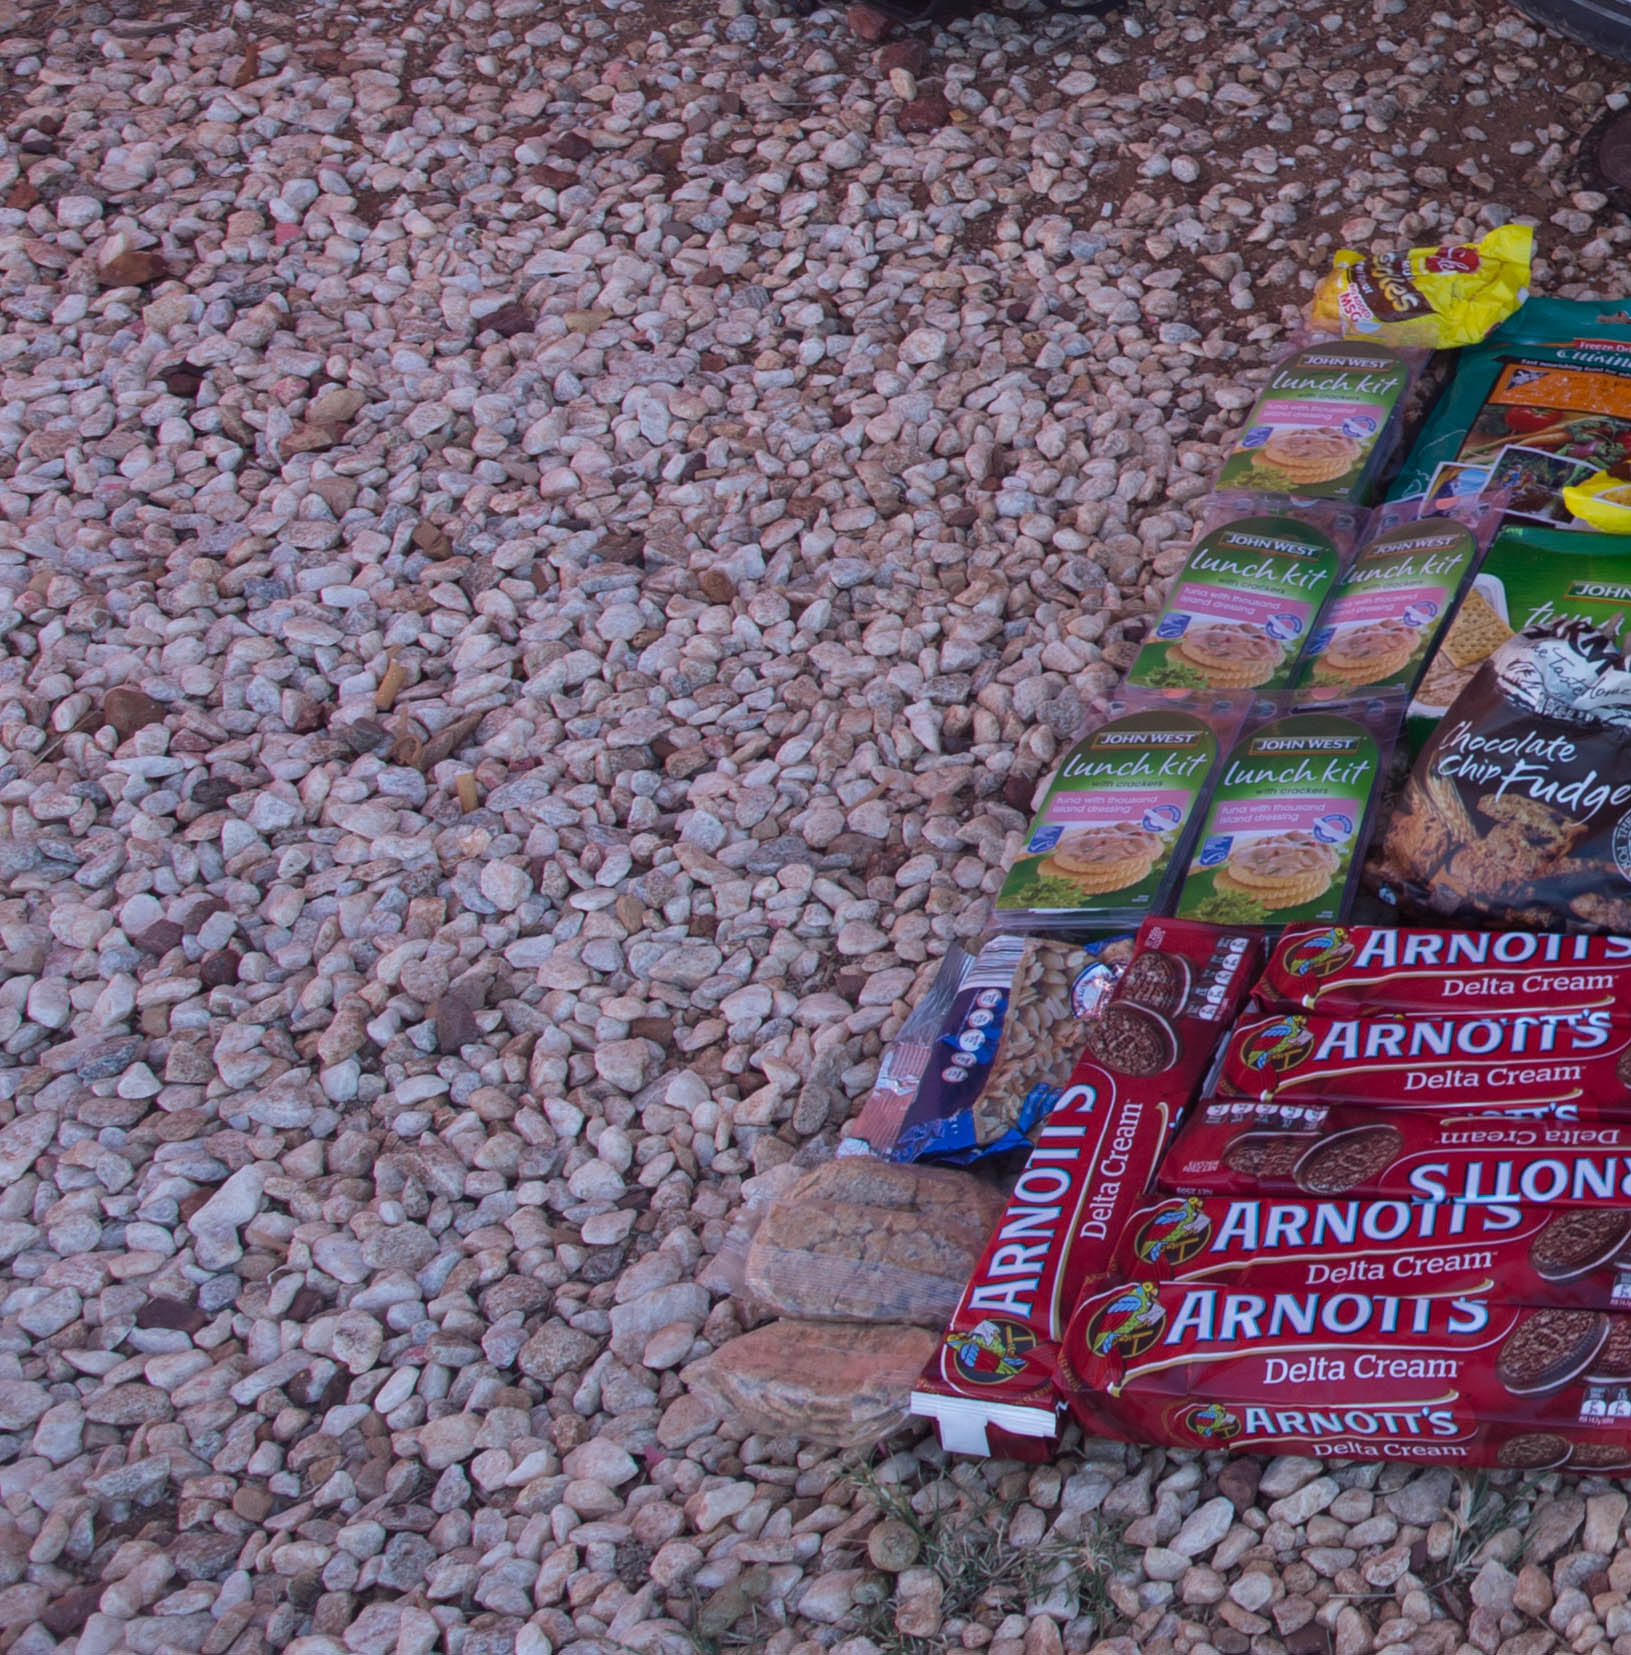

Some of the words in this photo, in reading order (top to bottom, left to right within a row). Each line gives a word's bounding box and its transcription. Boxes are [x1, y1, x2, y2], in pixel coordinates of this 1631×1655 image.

[1338, 292, 1363, 324] MSG
[1579, 341, 1613, 352] Freeze
[1303, 355, 1346, 365] JOHN
[1347, 358, 1387, 369] WEST
[1271, 370, 1352, 391] lunch
[1354, 374, 1400, 395] kit
[1226, 533, 1271, 549] JOHN
[1273, 541, 1317, 557] WEST
[1374, 543, 1412, 555] JOHN
[1415, 536, 1453, 549] WEST
[1190, 548, 1278, 581] lunch
[1280, 562, 1329, 591] kit
[1341, 556, 1418, 586] lunch
[1419, 553, 1464, 577] kit
[1100, 733, 1149, 745] JOHN
[1150, 733, 1196, 744] WEST
[1257, 739, 1305, 751] JOHN
[1306, 738, 1353, 750] WEST
[1438, 720, 1577, 764] Chocolate
[1062, 752, 1154, 778] lunch
[1157, 752, 1208, 777] kit
[1223, 757, 1318, 786] lunch
[1320, 757, 1371, 785] kit
[1437, 753, 1503, 785] Chip
[1440, 978, 1516, 997] Delta
[1521, 974, 1614, 994] Cream
[1404, 1070, 1480, 1091] Delta
[1486, 1065, 1582, 1087] Cream
[1099, 1101, 1144, 1180] Cream
[1440, 1128, 1532, 1145] Cream
[1545, 1127, 1620, 1145] Delta
[1080, 1181, 1121, 1240] Delta
[1304, 1263, 1386, 1286] Delta
[1392, 1251, 1494, 1279] Cream
[1263, 1357, 1346, 1385] Delta
[1353, 1355, 1459, 1379] Cream
[1245, 1406, 1460, 1436] ARNOTT'S
[1313, 1442, 1379, 1457] Delta
[1383, 1443, 1467, 1458] Cream
